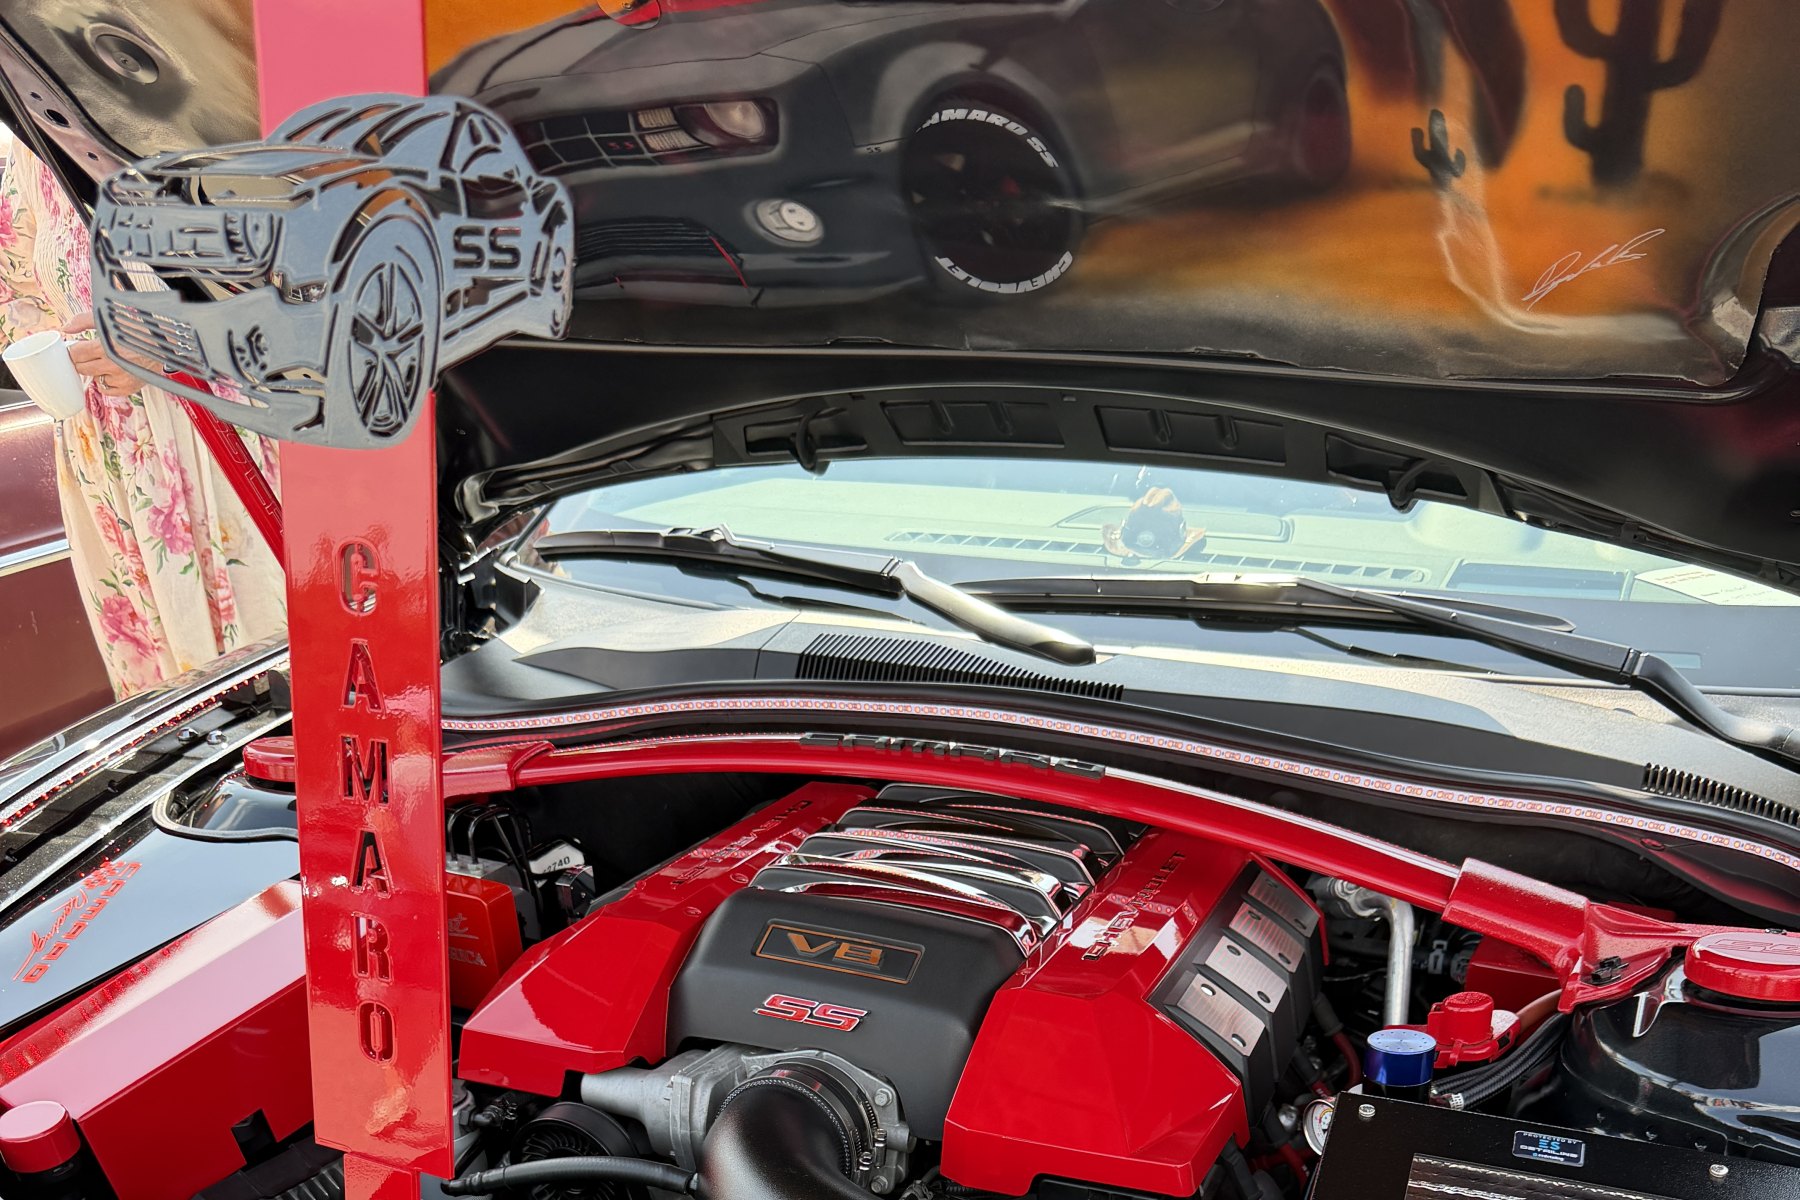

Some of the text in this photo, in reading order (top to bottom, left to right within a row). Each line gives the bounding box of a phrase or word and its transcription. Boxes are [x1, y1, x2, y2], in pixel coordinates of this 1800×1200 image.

[915, 108, 1059, 168] AMARO SS
[453, 225, 522, 270] SS
[934, 250, 1073, 294] CHEVROLET
[331, 535, 399, 1066] CAMARO
[1081, 850, 1186, 961] CHEVROLET
[786, 932, 884, 969] V8
[752, 993, 871, 1032] SS
[1519, 1144, 1579, 1159] DETAILING
[1522, 1132, 1566, 1143] PROTECTED
[1538, 1138, 1561, 1151] ES
